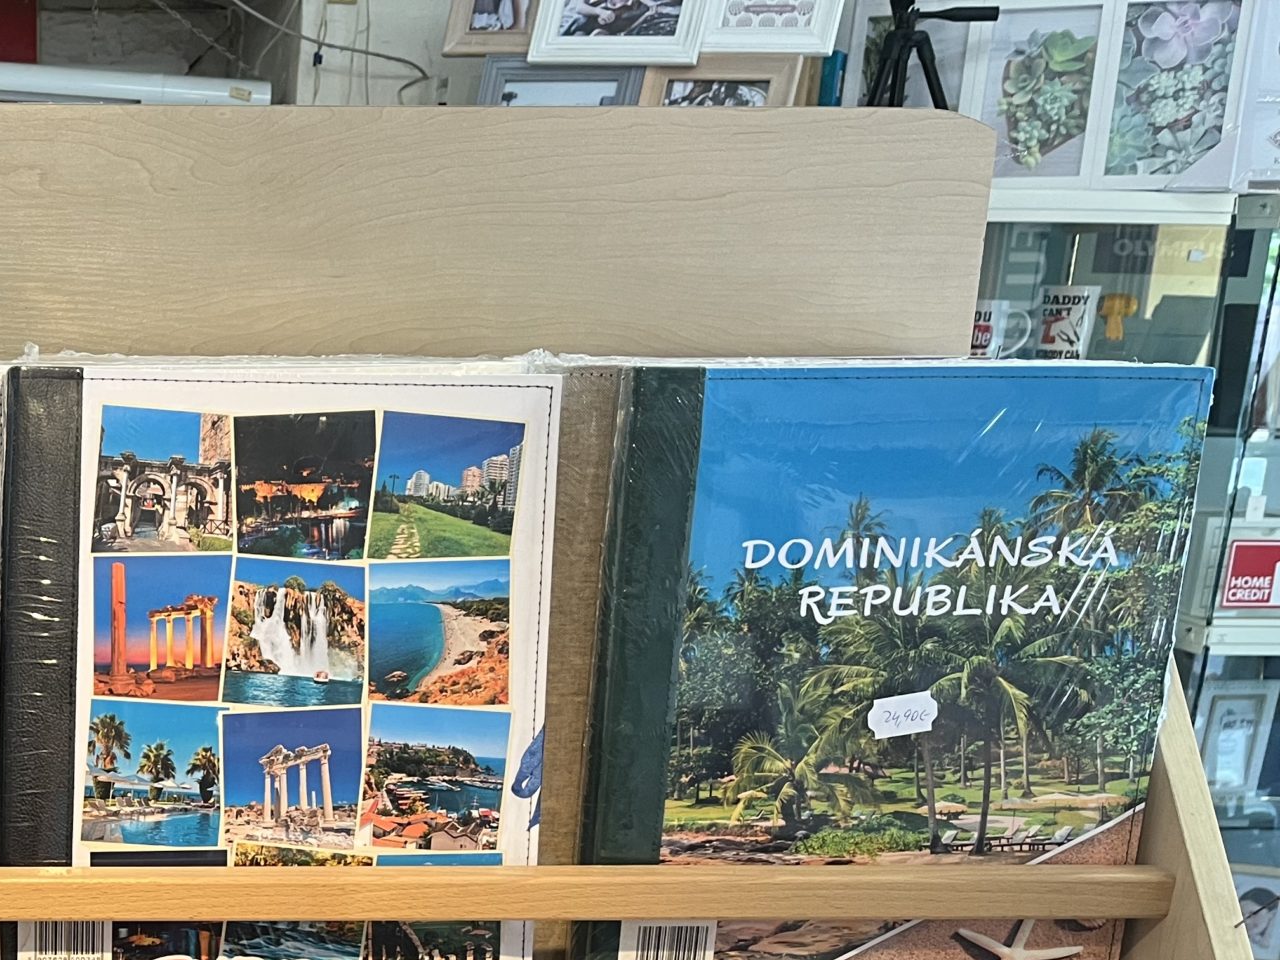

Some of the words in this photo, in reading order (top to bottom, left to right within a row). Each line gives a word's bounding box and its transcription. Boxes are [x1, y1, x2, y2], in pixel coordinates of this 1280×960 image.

[1042, 294, 1090, 306] DADDY
[974, 310, 993, 322] OU
[741, 527, 1120, 570] DOMINIKÁNSKÁ
[1230, 575, 1273, 588] HOME
[1227, 588, 1271, 601] CREDIT
[798, 584, 1062, 625] REPUBLIKA
[882, 708, 931, 729] 24,90€
